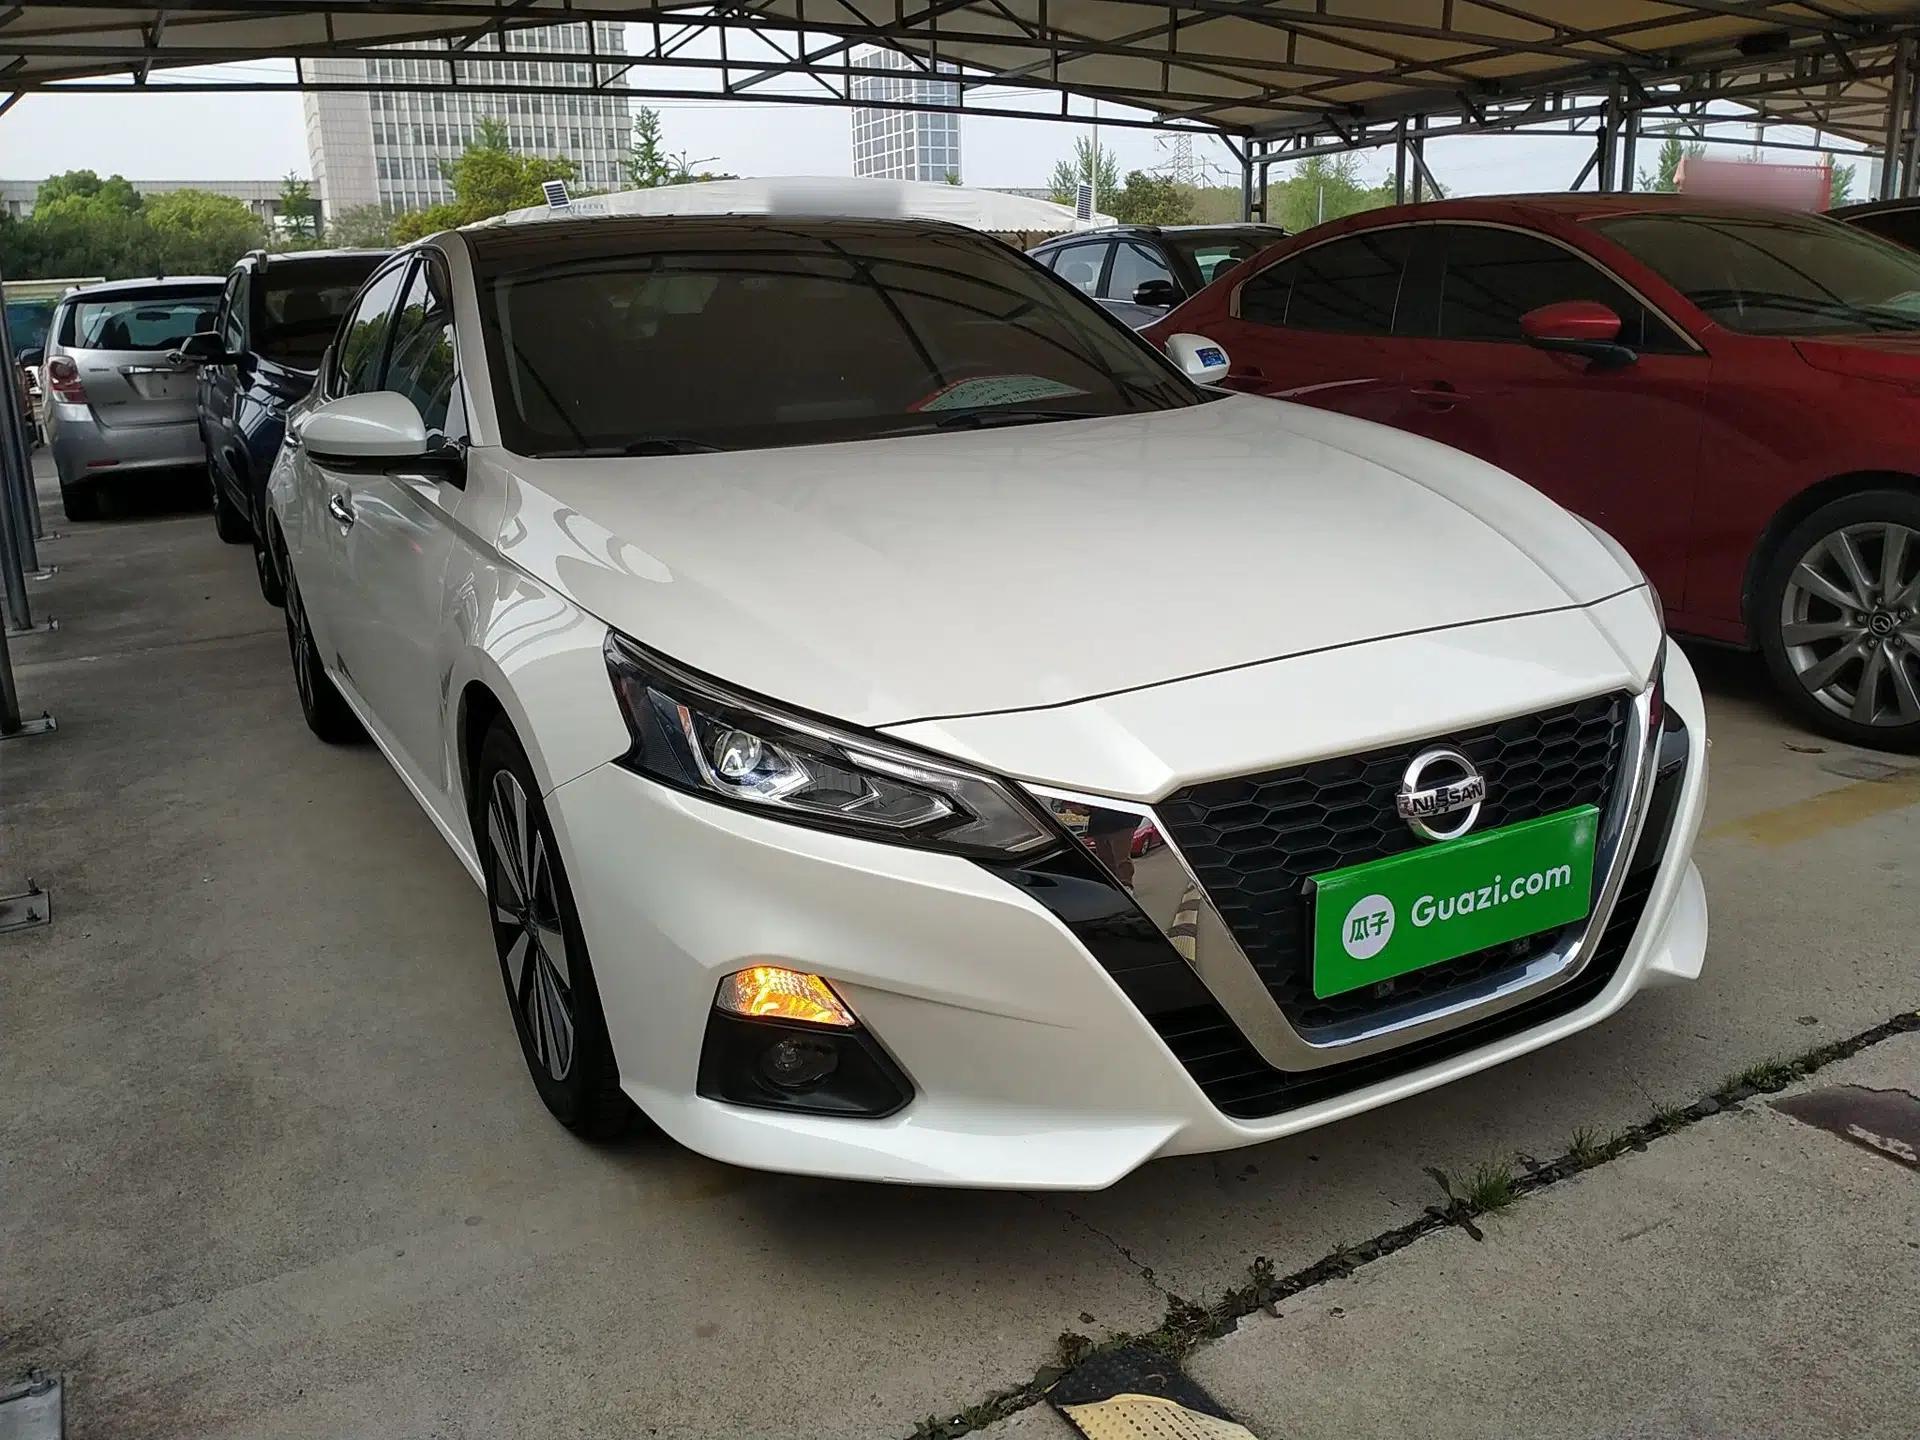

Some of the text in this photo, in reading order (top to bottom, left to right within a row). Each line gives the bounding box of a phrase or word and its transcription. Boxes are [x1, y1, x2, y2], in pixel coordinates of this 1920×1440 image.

[1412, 781, 1483, 813] NISSAN
[1410, 864, 1572, 928] Guazi.com
[1349, 911, 1390, 943] 瓜子
